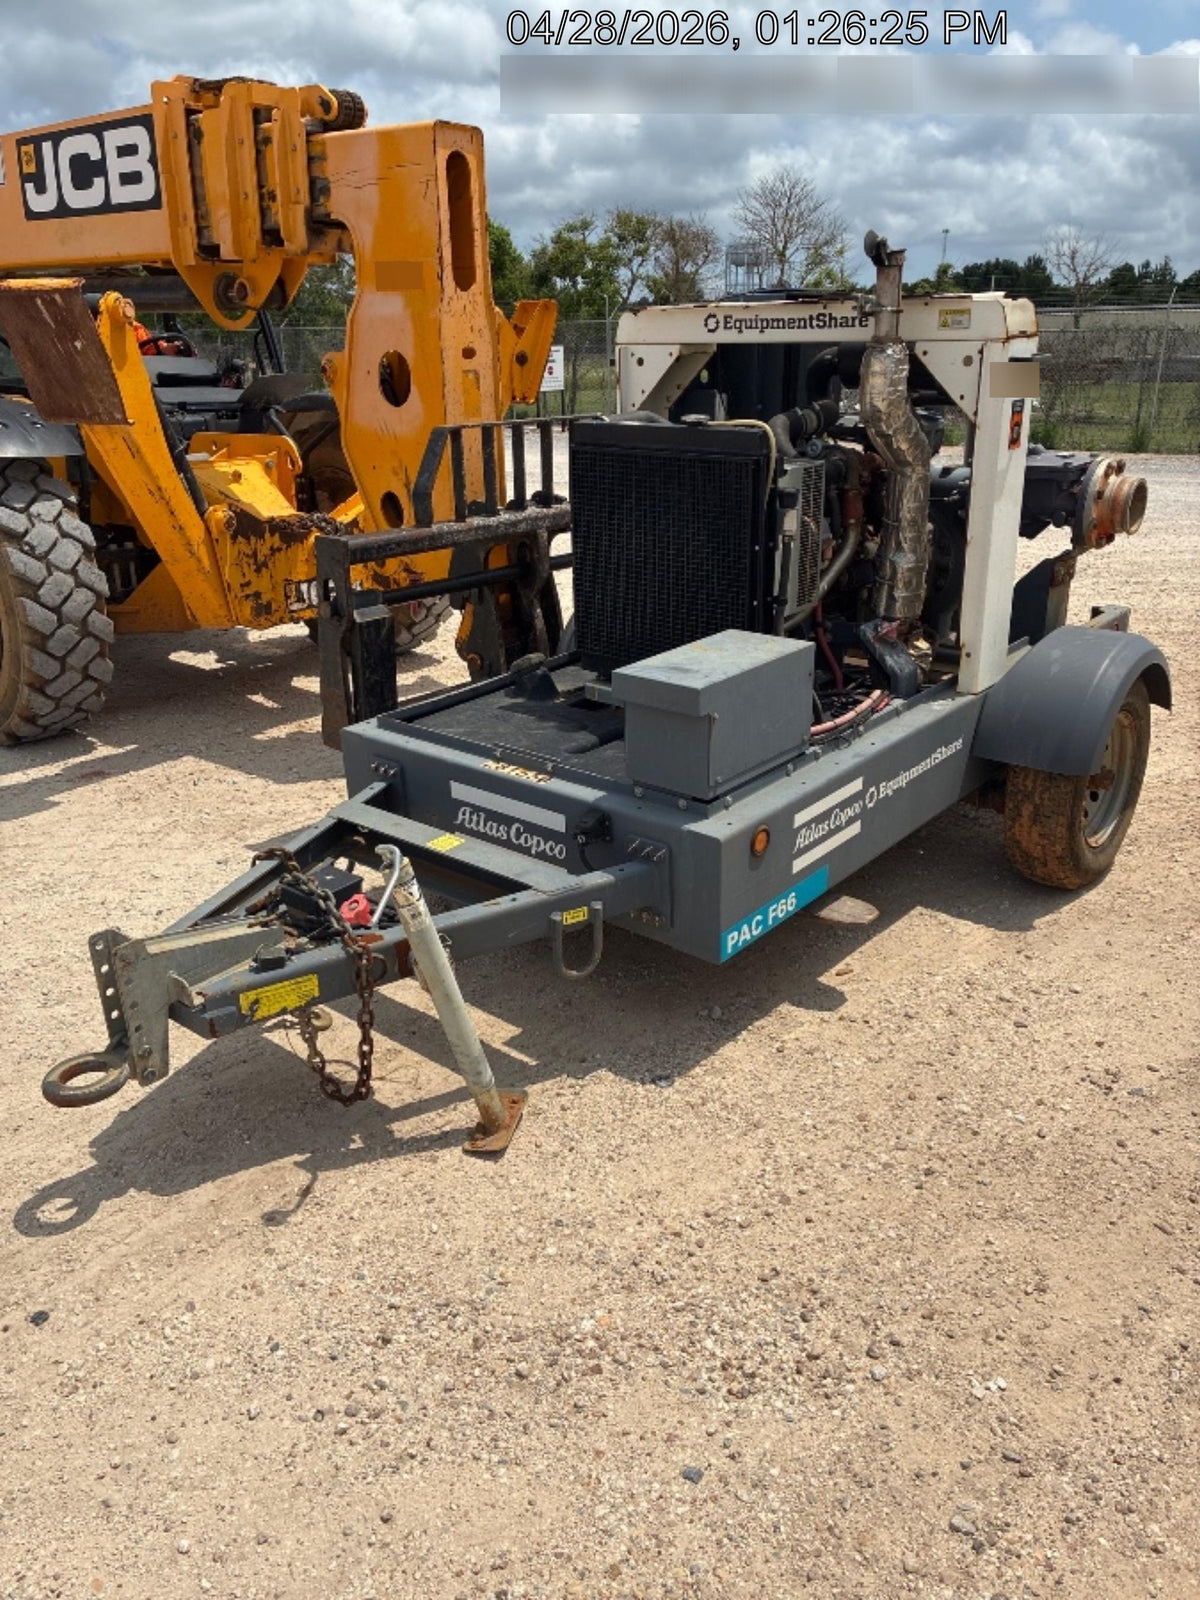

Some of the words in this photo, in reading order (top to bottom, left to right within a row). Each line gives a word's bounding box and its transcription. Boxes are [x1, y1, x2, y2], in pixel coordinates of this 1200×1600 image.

[24, 125, 156, 212] JCB
[723, 312, 869, 334] EquipmentShare
[878, 737, 964, 800] EquipmentShare
[453, 806, 508, 840] Atlas
[510, 822, 566, 860] Copco
[792, 820, 829, 854] Atlas
[830, 799, 863, 831] Copco
[727, 915, 763, 954] PAC
[768, 892, 797, 925] F66
